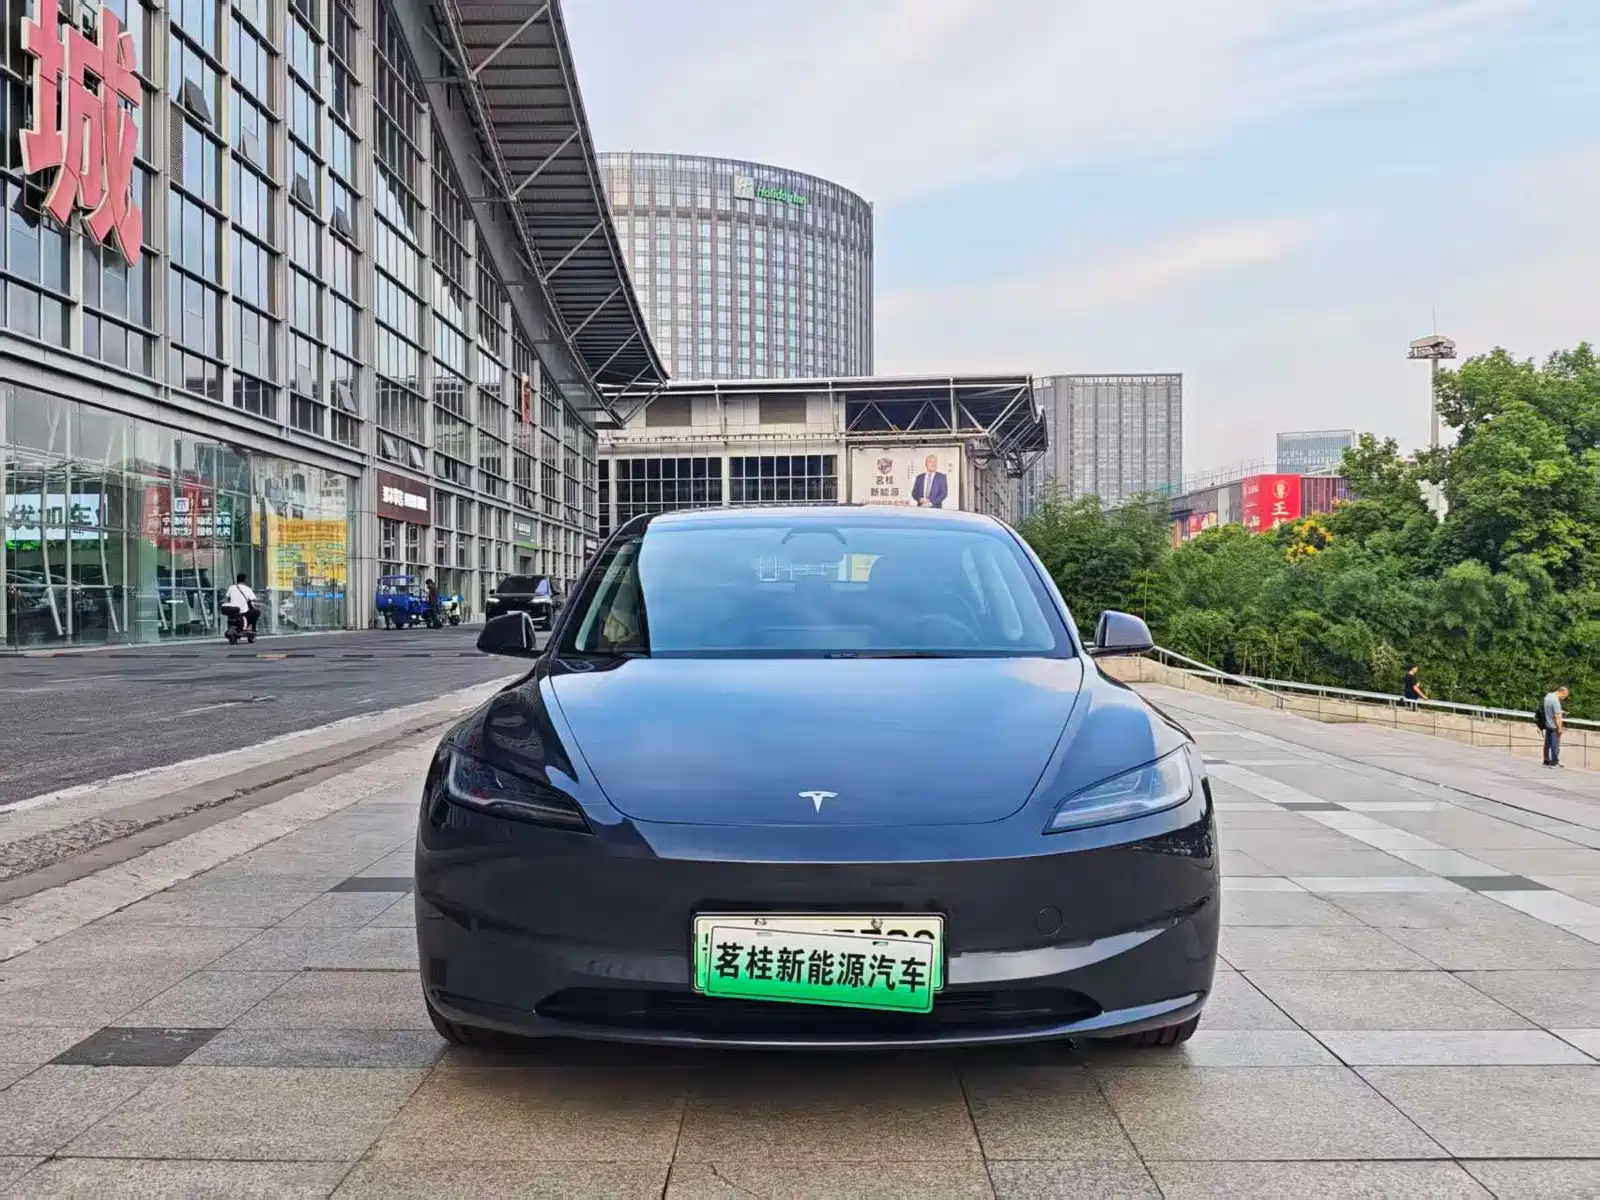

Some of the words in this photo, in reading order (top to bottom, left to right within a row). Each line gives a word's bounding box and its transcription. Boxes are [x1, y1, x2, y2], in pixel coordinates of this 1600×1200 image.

[20, 0, 142, 267] 城
[757, 186, 793, 204] Holiday
[870, 487, 900, 497] 新能源
[715, 942, 926, 993] 茗桂新能源汽车
